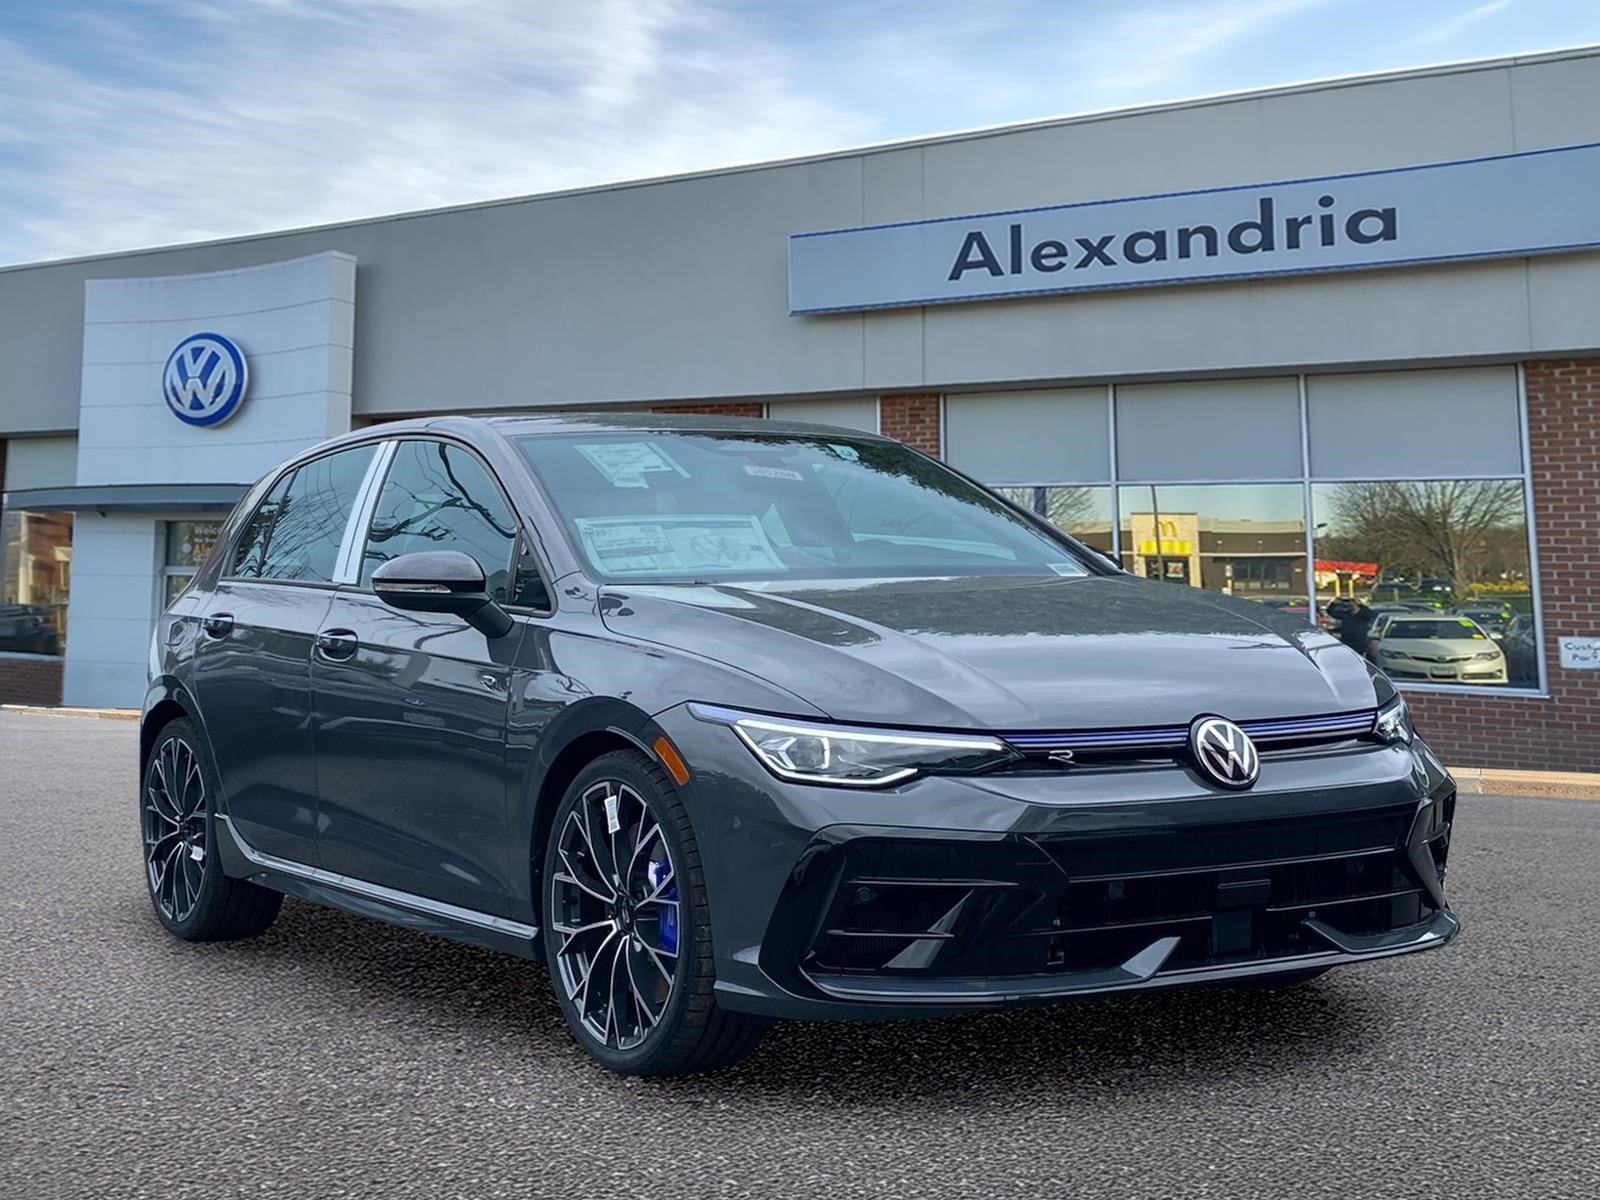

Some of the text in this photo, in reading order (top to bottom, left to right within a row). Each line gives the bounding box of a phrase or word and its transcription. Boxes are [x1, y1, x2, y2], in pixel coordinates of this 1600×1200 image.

[948, 195, 1397, 281] Alexandria
[167, 338, 237, 418] VW
[1564, 642, 1594, 651] Cust
[1199, 721, 1257, 783] VW
